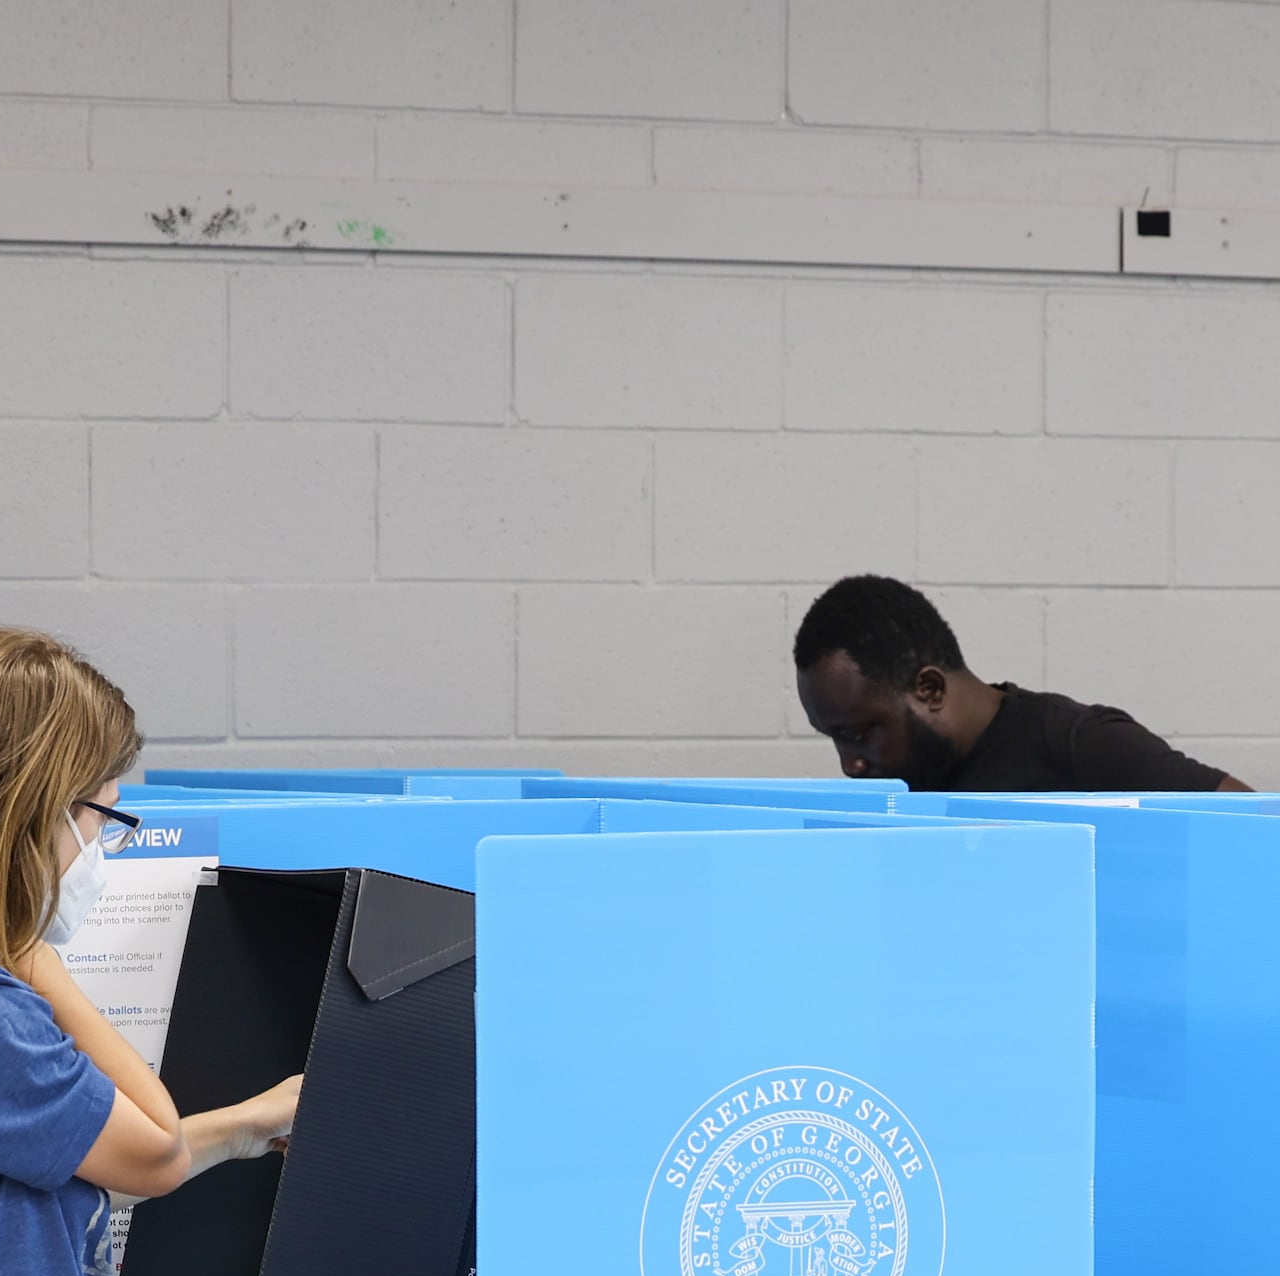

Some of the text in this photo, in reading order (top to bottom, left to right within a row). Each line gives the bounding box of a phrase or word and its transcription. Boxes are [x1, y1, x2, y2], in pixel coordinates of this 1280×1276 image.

[127, 828, 183, 848] VIEW
[104, 894, 124, 902] your
[125, 893, 155, 902] printed
[157, 892, 181, 900] ballot
[182, 892, 191, 900] to
[98, 906, 118, 915] your
[119, 904, 152, 913] choices
[153, 904, 174, 913] prior
[83, 917, 103, 927] rting
[104, 917, 120, 925] into
[122, 917, 136, 925] the
[66, 952, 163, 963] Contact Poll Official if
[112, 965, 119, 973] is
[108, 1006, 142, 1015] ballots
[665, 1078, 924, 1189] SECRETARY OF STATE
[754, 1162, 840, 1197] CONSTITUTION
[693, 1126, 895, 1269] STATE OF GEORGIA
[776, 1230, 817, 1245] JUSTICE
[830, 1233, 861, 1254] MODER
